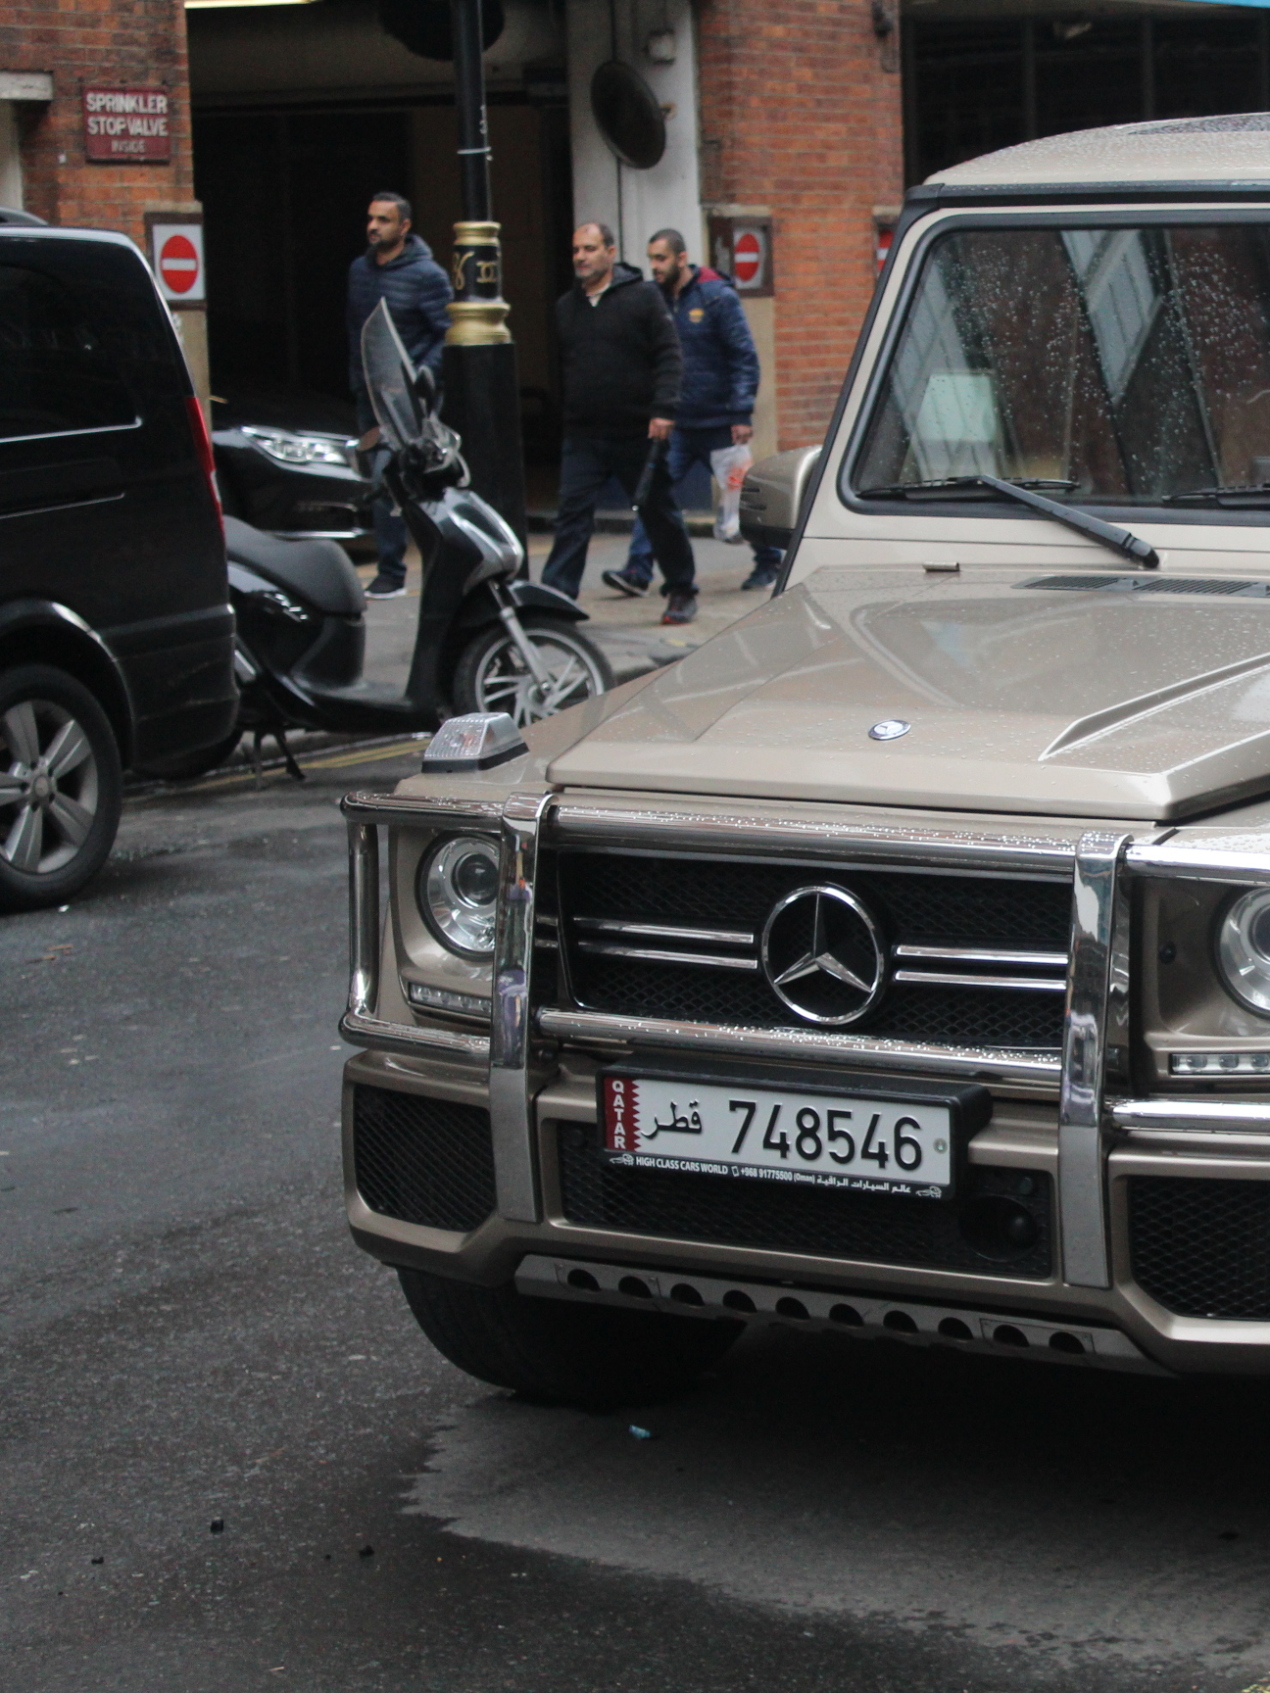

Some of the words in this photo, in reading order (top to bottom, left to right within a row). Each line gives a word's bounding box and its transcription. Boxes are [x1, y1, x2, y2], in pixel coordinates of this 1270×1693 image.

[86, 92, 168, 114] SPRINKLER
[87, 116, 126, 136] STOP
[126, 117, 169, 137] VALVE
[111, 140, 146, 153] INSIDE
[612, 1080, 626, 1149] QATAR
[640, 1098, 703, 1140] قطر
[728, 1098, 923, 1172] 748546
[636, 1156, 656, 1167] HIGH
[656, 1159, 680, 1170] CLASS
[680, 1161, 700, 1172] CARS
[701, 1163, 729, 1175] WORLD
[741, 1168, 758, 1178] +968
[758, 1168, 793, 1182] 91775500
[816, 1174, 849, 1187] الراقية
[851, 1178, 890, 1192] السيارات
[891, 1183, 911, 1194] عالم
